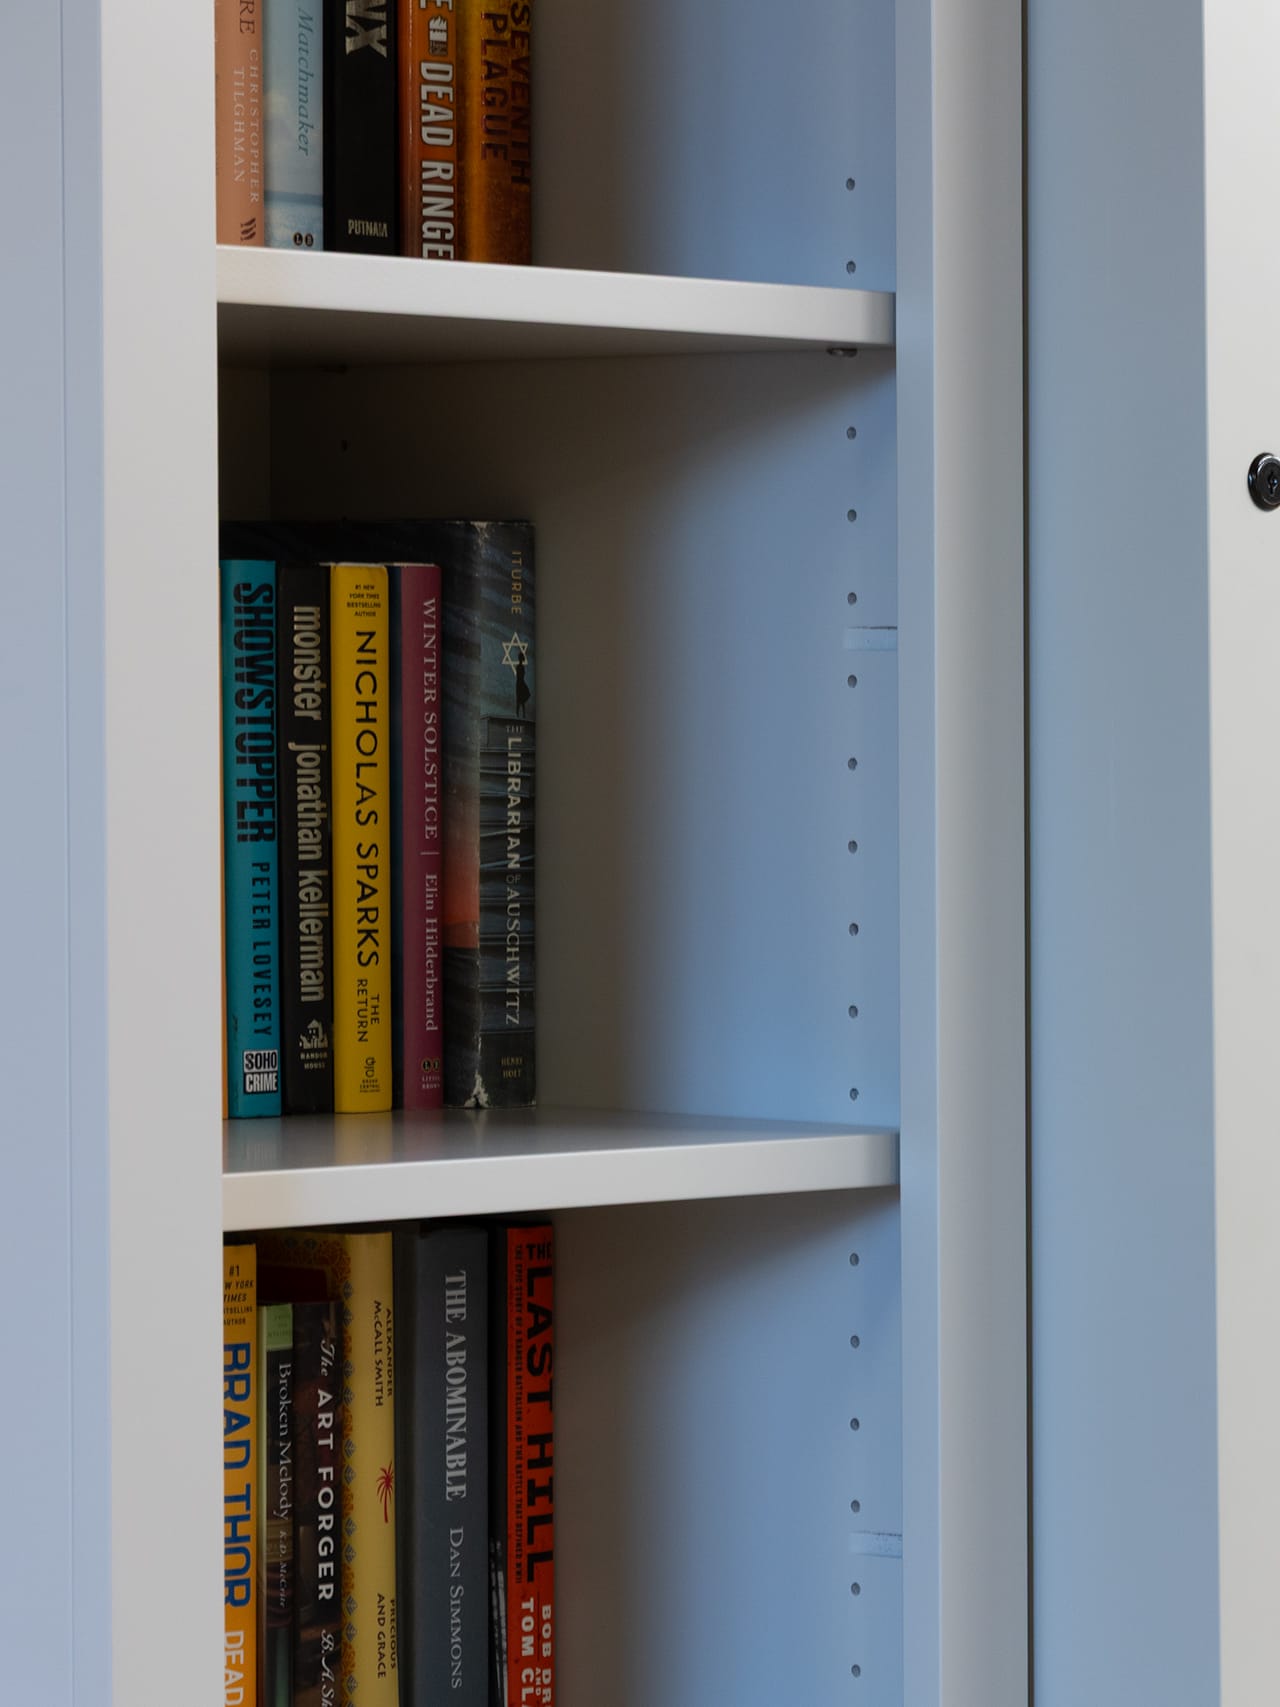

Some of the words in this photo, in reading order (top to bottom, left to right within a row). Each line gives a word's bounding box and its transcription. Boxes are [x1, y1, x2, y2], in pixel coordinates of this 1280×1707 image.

[233, 68, 246, 183] TILGHMAN
[248, 49, 259, 203] CHRISTOPHER
[297, 7, 314, 156] Matchmaker
[420, 62, 454, 147] DEAD
[481, 11, 508, 161] PLAGUE
[510, 1, 531, 186] SEVENTH
[348, 219, 388, 238] PUTNAM
[511, 550, 522, 615] ITURBE
[293, 606, 326, 721] monster
[423, 597, 438, 703] WINTER
[233, 582, 276, 842] SHOWSTOPPER
[355, 630, 378, 826] NICHOLAS
[288, 741, 327, 861] jonathan
[424, 712, 440, 840] SOLSTICE
[507, 737, 522, 868] LIBRARIAN
[251, 862, 271, 930] PETER
[297, 869, 328, 1003] kellerman
[355, 842, 380, 968] SPARKS
[424, 874, 439, 911] Elin
[252, 941, 273, 1036] LOVESEY
[424, 918, 439, 1031] Hilderbrand
[505, 888, 521, 1025] AUSCHWITZ
[357, 978, 369, 1043] RETURN
[371, 993, 380, 1025] THE
[244, 1051, 278, 1071] SOHO
[244, 1072, 278, 1093] CRIME
[445, 1270, 467, 1323] THE
[527, 1267, 553, 1412] LAST
[320, 1339, 335, 1377] The
[374, 1359, 383, 1407] SMITH
[385, 1308, 394, 1397] ALEXANDER
[224, 1342, 251, 1470] BRAD
[278, 1363, 292, 1436] Broken
[317, 1390, 334, 1451] ART
[445, 1331, 467, 1501] ABOMINABLE
[273, 1440, 292, 1520] Melody
[527, 1432, 553, 1583] HILL
[224, 1483, 251, 1607] THOR
[318, 1466, 335, 1601] FORGER
[449, 1527, 464, 1577] DAN
[376, 1593, 386, 1625] AND
[389, 1599, 397, 1669] PRECIOUS
[449, 1585, 464, 1689] SIMMONS
[521, 1596, 535, 1657] TOM
[542, 1604, 552, 1658] BOB
[225, 1630, 245, 1706] DEAD
[377, 1631, 387, 1679] GRACE
[521, 1667, 535, 1707] CL
[542, 1667, 552, 1707] DR
